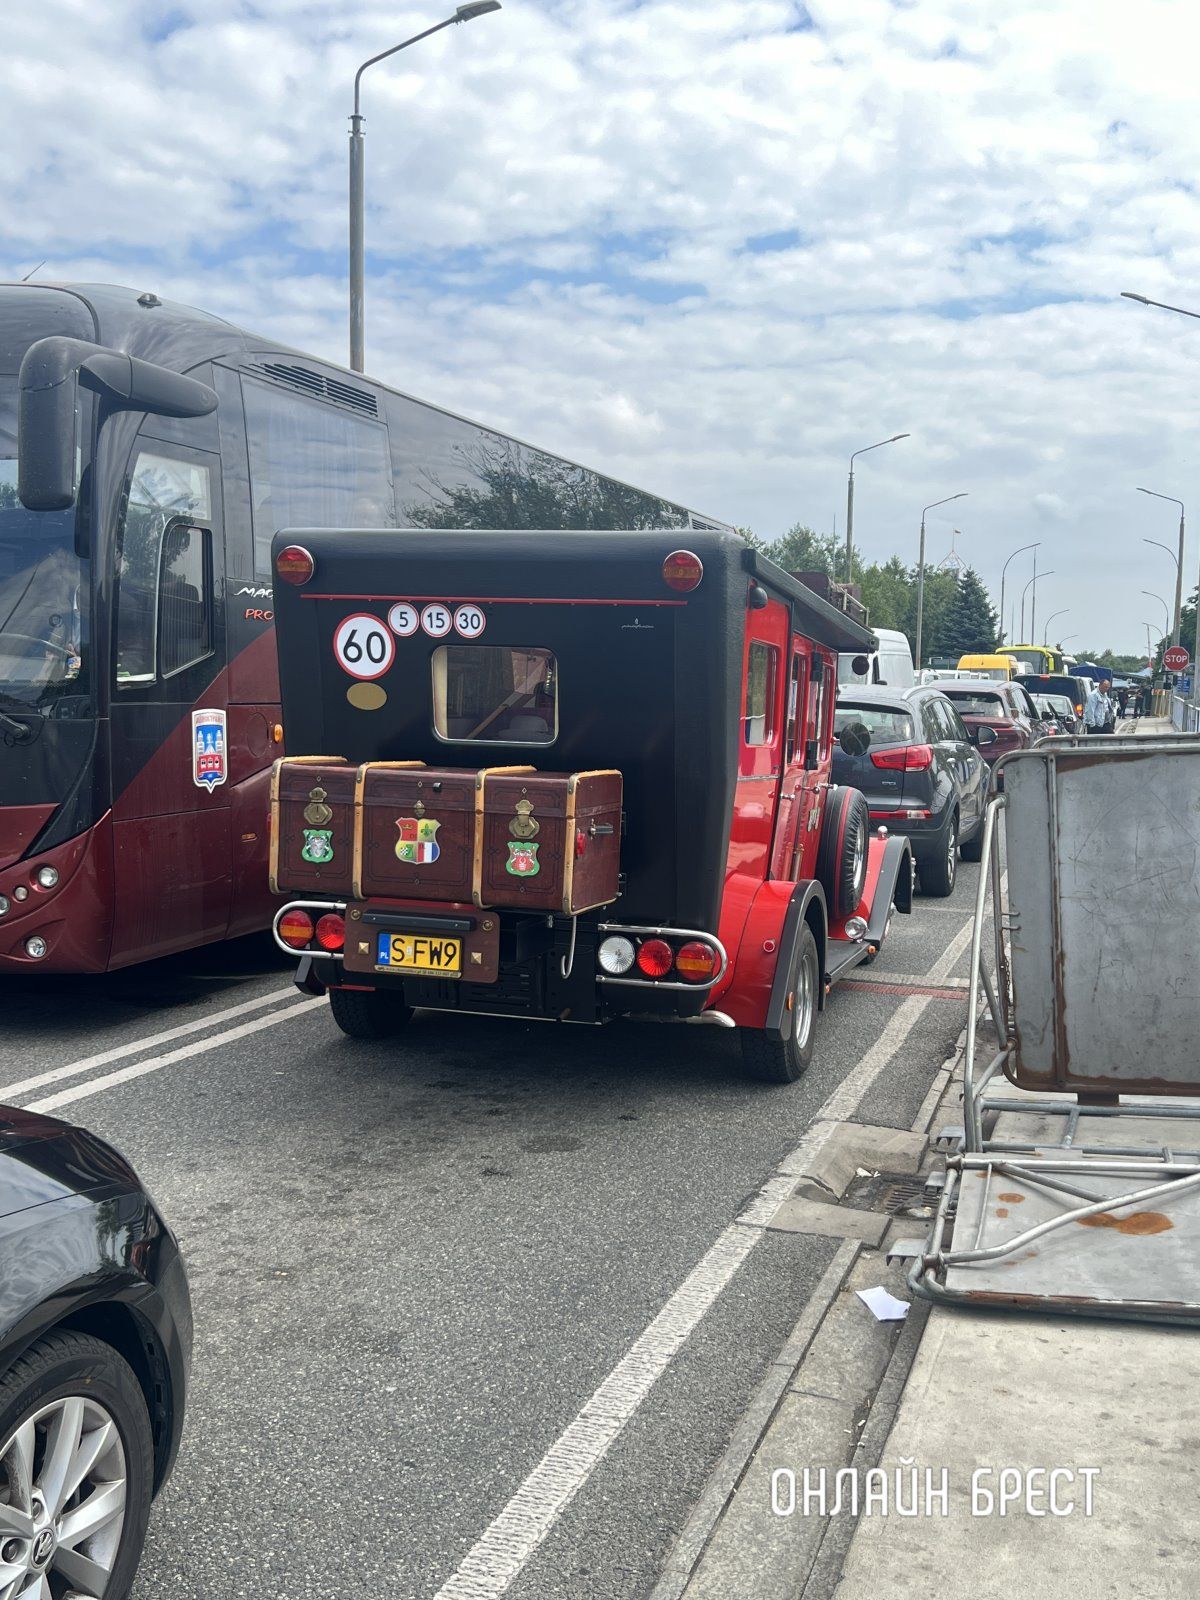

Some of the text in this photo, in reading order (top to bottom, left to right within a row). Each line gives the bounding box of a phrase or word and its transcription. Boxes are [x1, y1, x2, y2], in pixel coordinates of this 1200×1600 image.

[245, 608, 274, 621] PRO
[399, 611, 409, 628] 5
[427, 612, 445, 629] 15
[459, 612, 481, 630] 30
[342, 628, 387, 664] 60
[1165, 654, 1188, 663] STOP
[380, 951, 389, 960] PL
